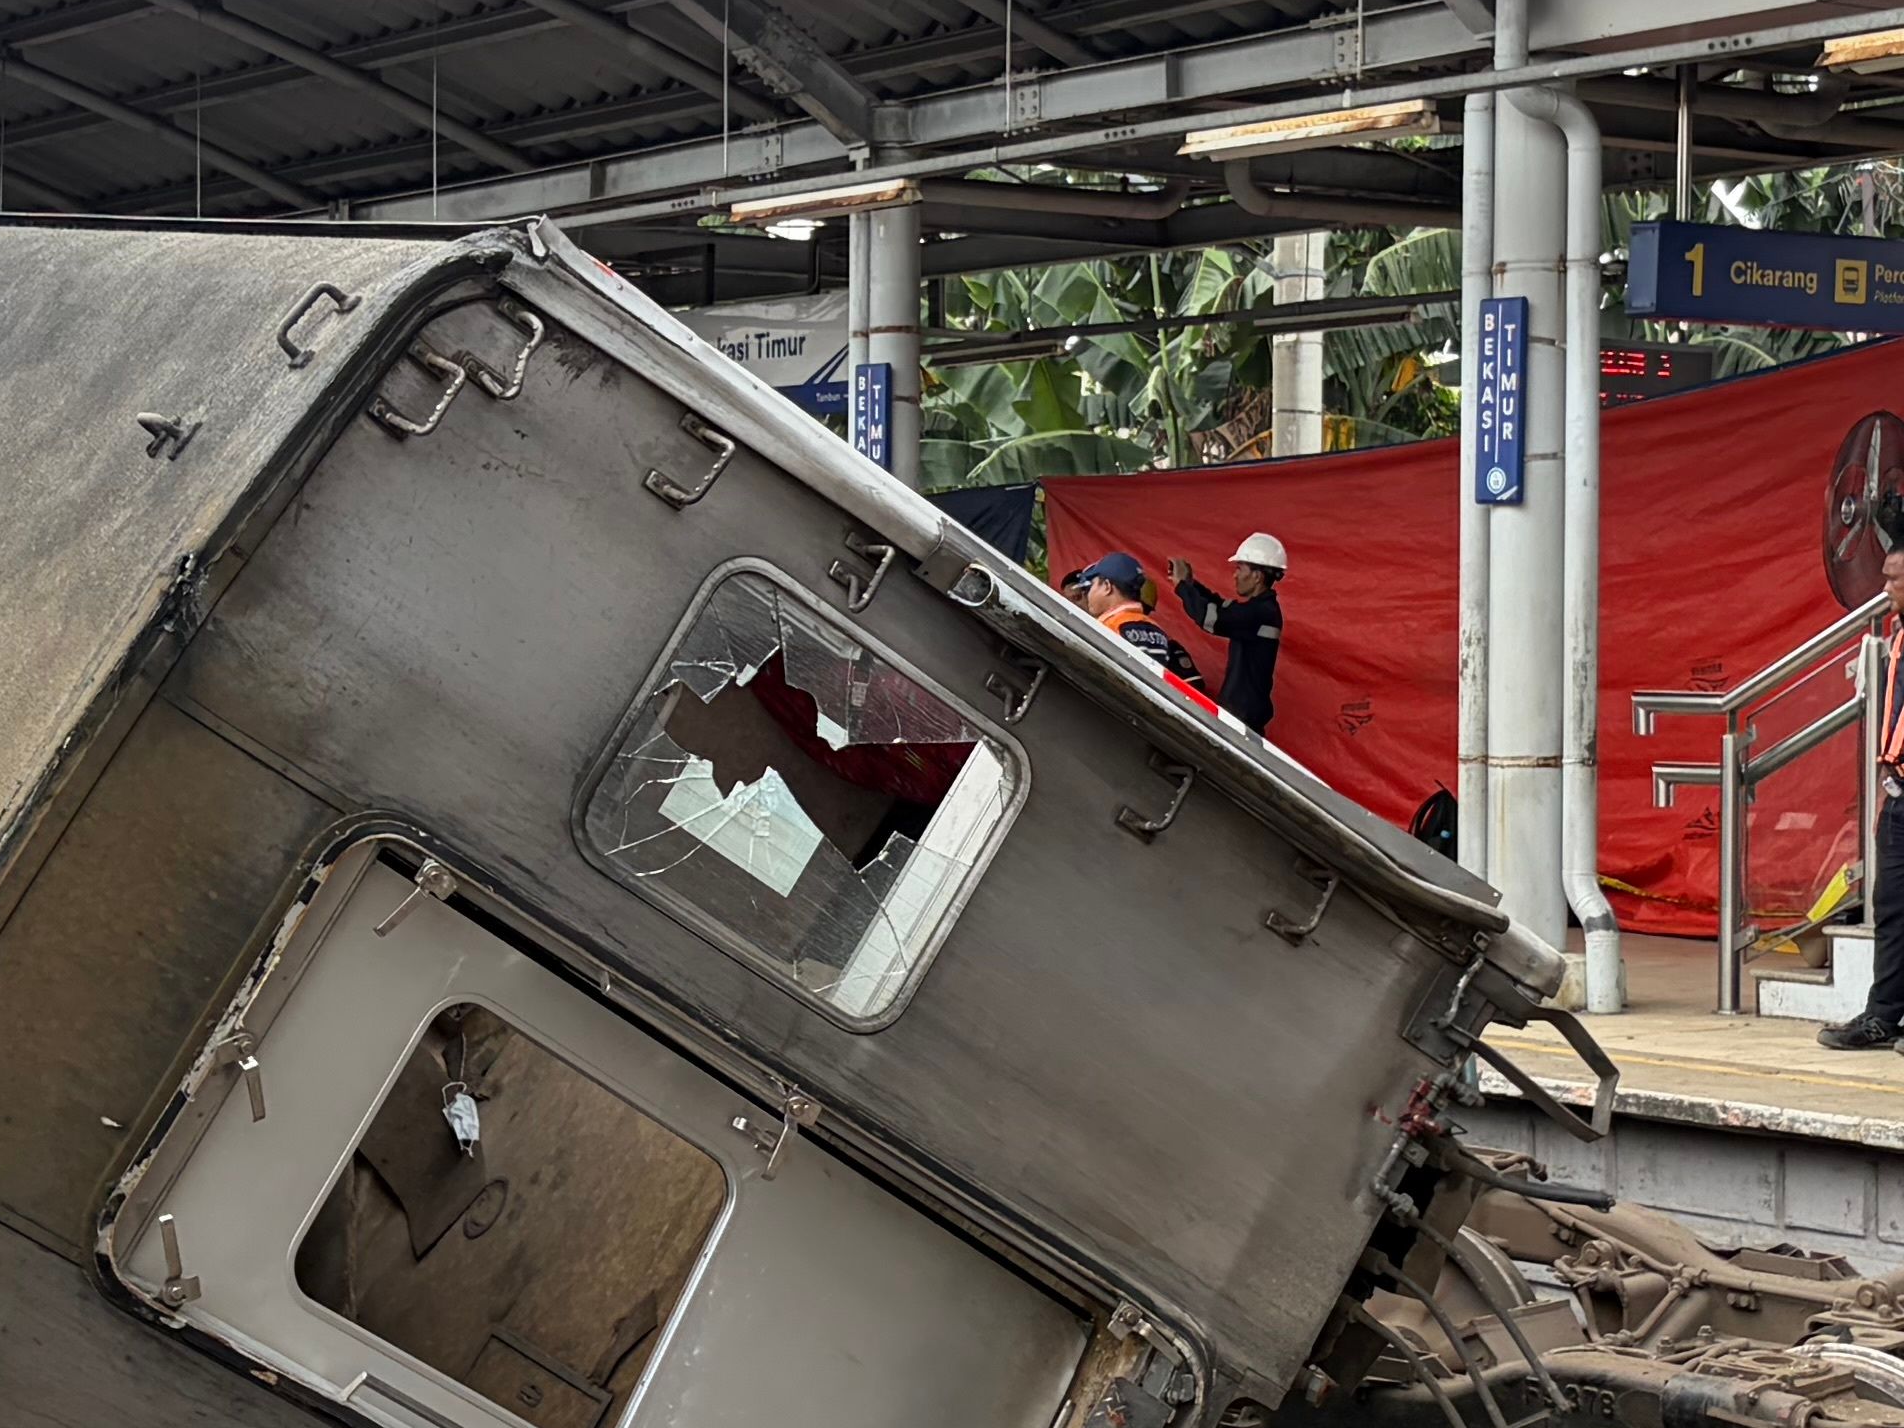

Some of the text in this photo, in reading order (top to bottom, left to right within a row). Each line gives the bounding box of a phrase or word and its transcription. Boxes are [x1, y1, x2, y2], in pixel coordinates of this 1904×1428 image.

[1684, 243, 1705, 297] 1
[1730, 260, 1818, 295] Cikarang
[754, 332, 806, 359] Timur
[1481, 313, 1495, 453] BEKASI
[1501, 323, 1517, 440] TIMUR
